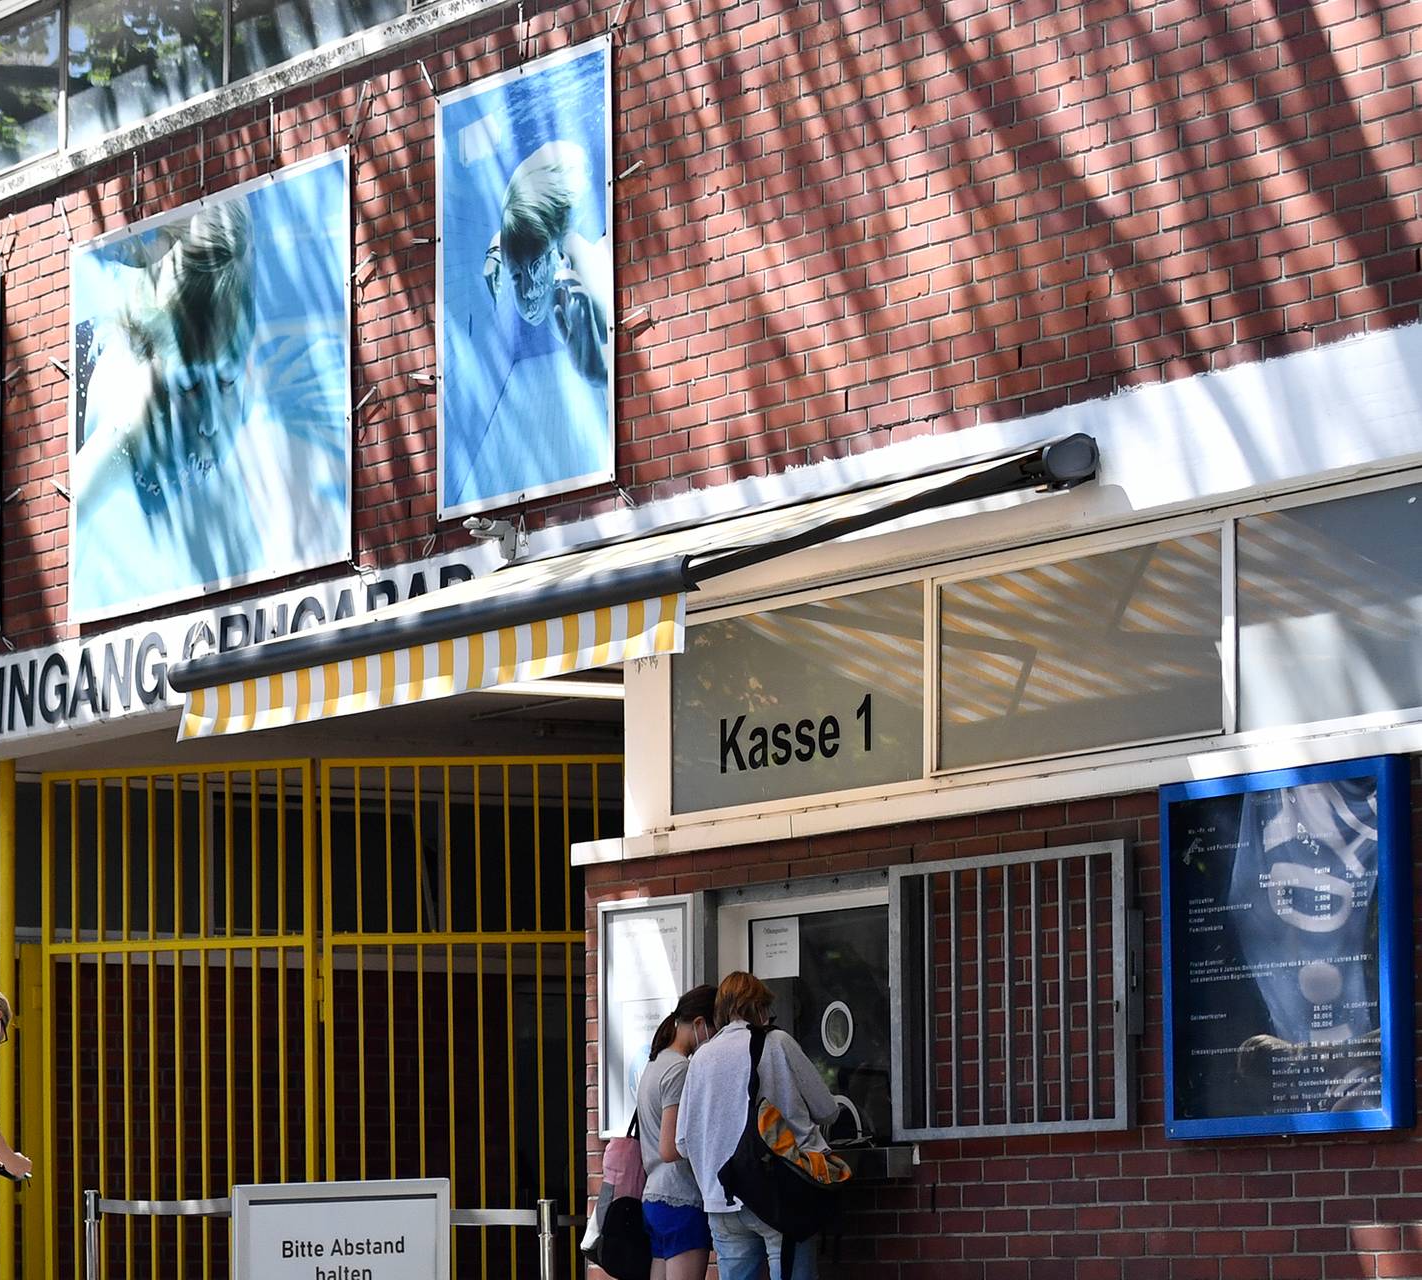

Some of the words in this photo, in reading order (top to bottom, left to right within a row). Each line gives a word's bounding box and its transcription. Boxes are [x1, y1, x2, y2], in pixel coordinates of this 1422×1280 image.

[720, 714, 840, 774] Kasse
[856, 693, 872, 752] 1
[282, 1240, 324, 1258] Bitte
[330, 1236, 405, 1256] Abstand
[316, 1266, 372, 1280] halten
